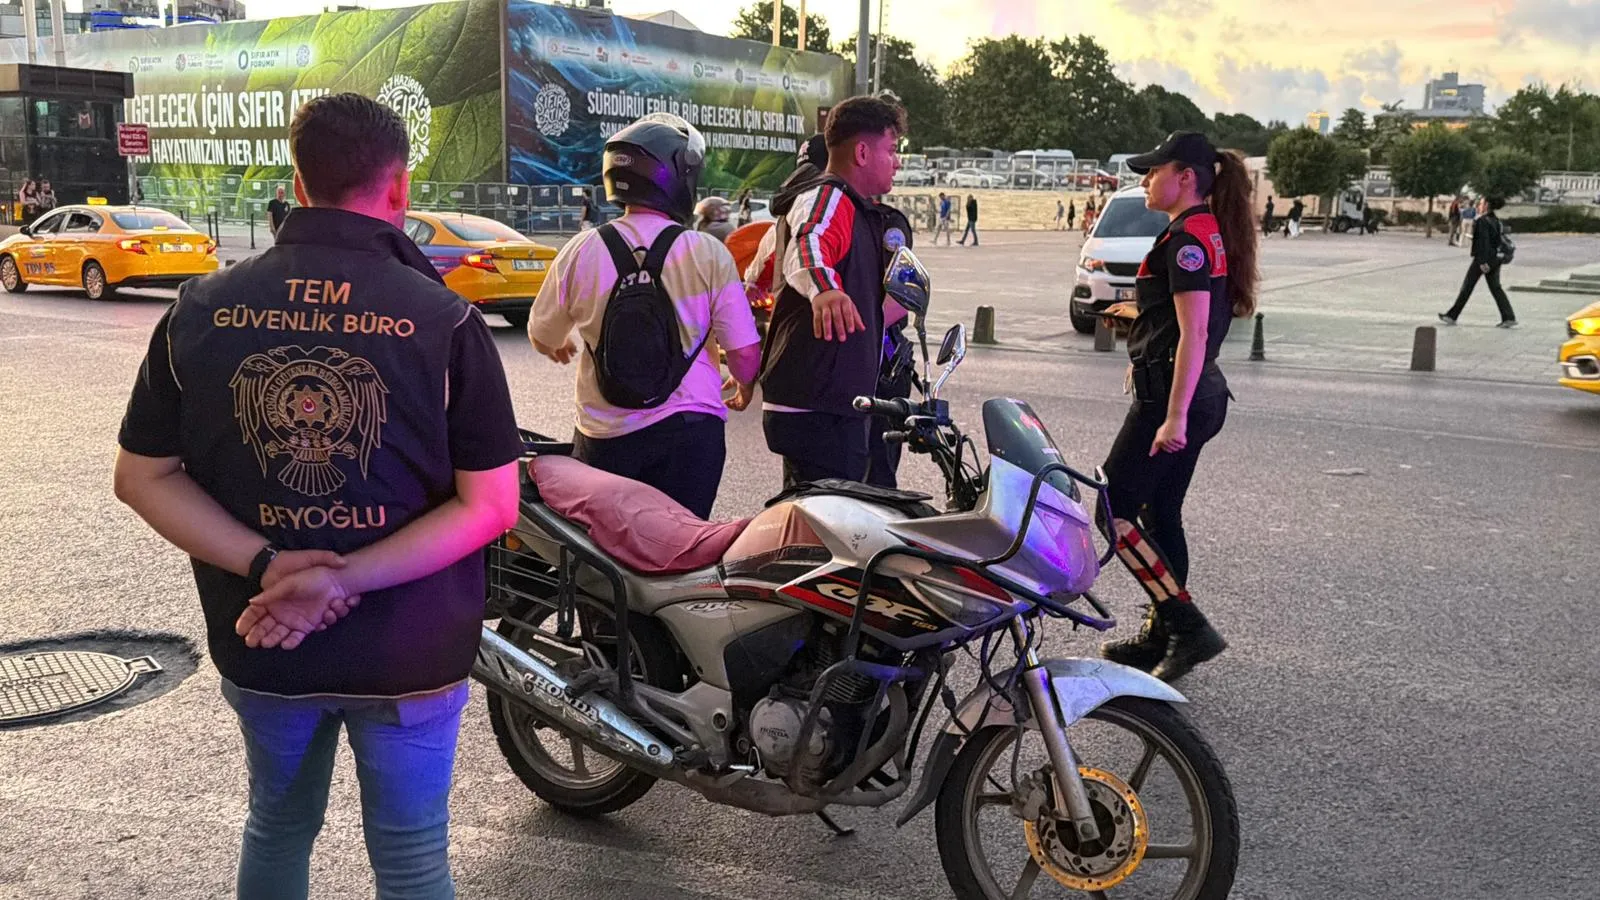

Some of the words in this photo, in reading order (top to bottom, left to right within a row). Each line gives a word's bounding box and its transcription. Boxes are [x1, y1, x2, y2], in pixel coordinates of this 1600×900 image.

[131, 92, 199, 128] GELECEK
[201, 84, 235, 135] İÇİN
[238, 90, 285, 128] SIFIR
[682, 98, 699, 125] BİR
[701, 105, 742, 129] GELECEK
[743, 104, 761, 133] İÇİN
[763, 111, 785, 132] SIFIR
[786, 115, 806, 135] ATIK
[152, 138, 225, 165] HAYATIMIZIN
[227, 138, 253, 166] HER
[755, 136, 769, 151] HER
[285, 278, 352, 304] TEM
[213, 304, 336, 333] GÜVENLİK
[343, 311, 415, 338] BÜRO
[259, 500, 386, 530] BEYOĞLU
[534, 674, 600, 722] HONDA
[760, 726, 790, 739] HONDA
